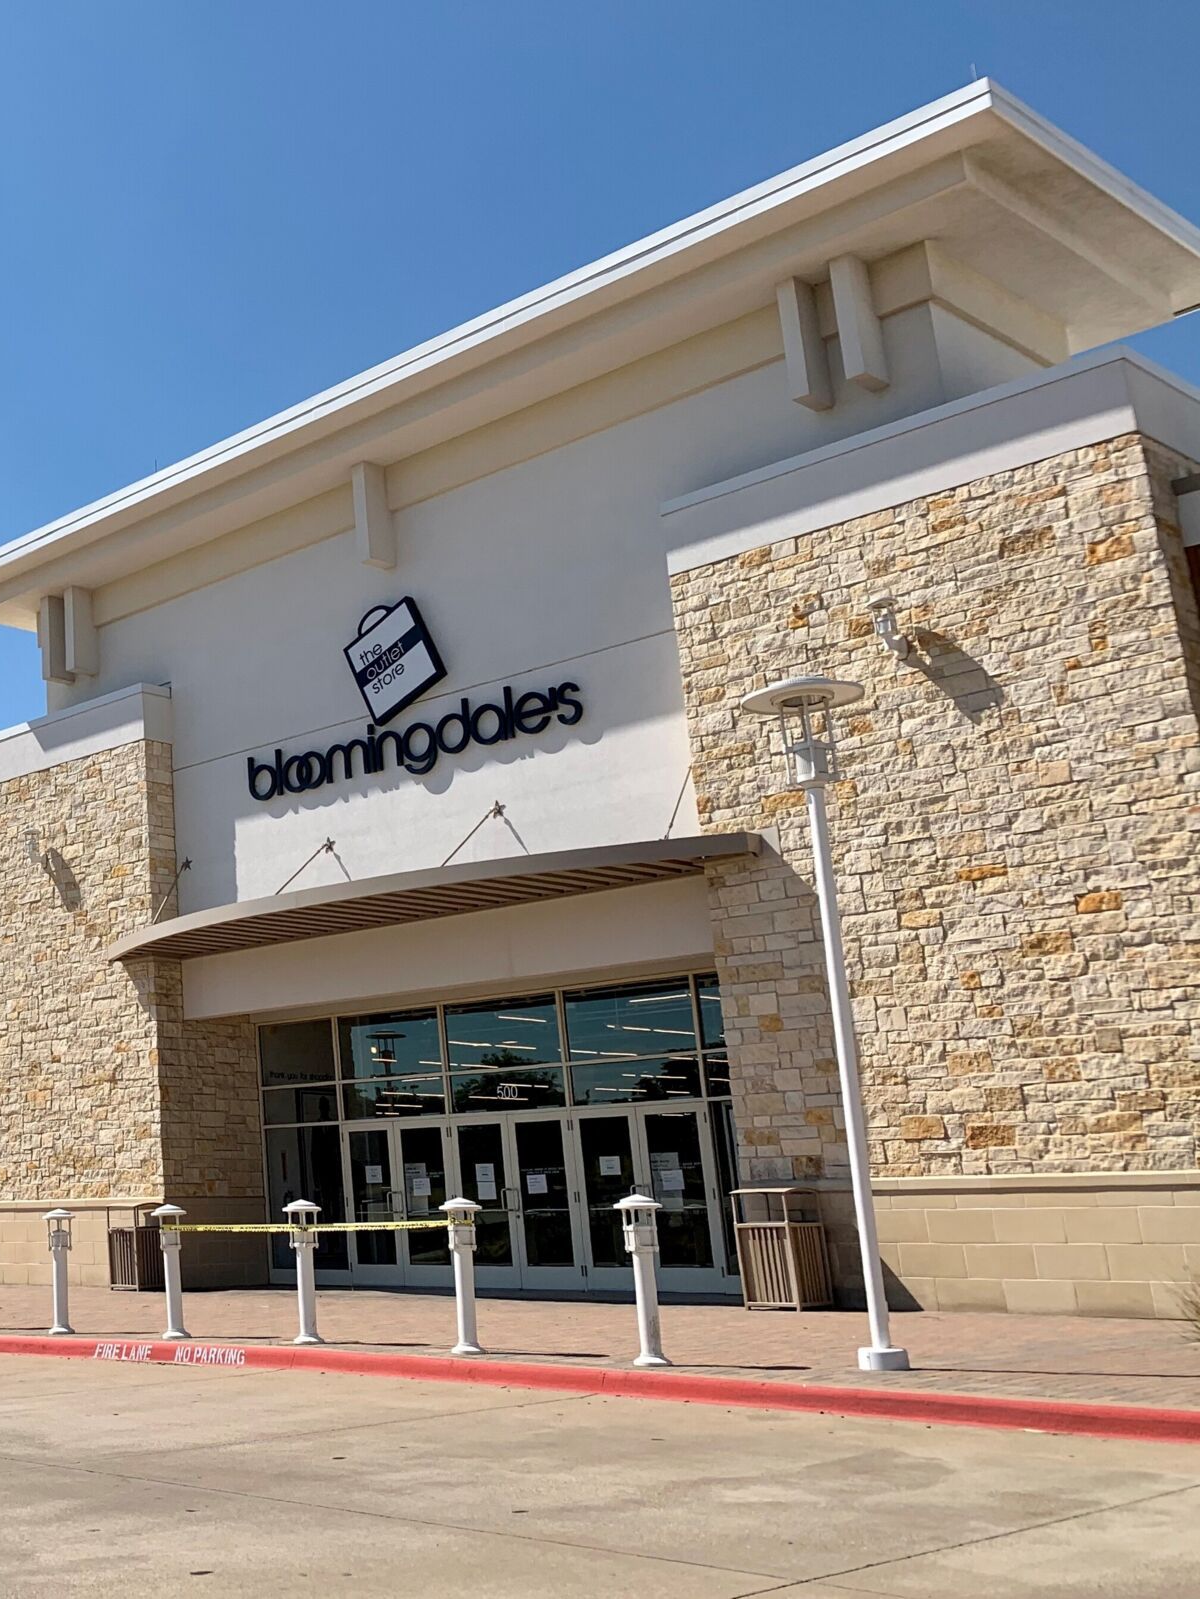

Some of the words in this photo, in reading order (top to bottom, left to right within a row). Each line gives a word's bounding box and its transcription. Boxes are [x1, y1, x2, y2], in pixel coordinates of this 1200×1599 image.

[359, 643, 383, 666] the
[366, 641, 405, 680] outlet
[372, 663, 405, 694] store
[496, 1084, 518, 1099] 500
[93, 1343, 122, 1360] FIRE
[121, 1344, 152, 1361] LANE
[174, 1346, 192, 1363] NO
[193, 1347, 246, 1365] PARKING
